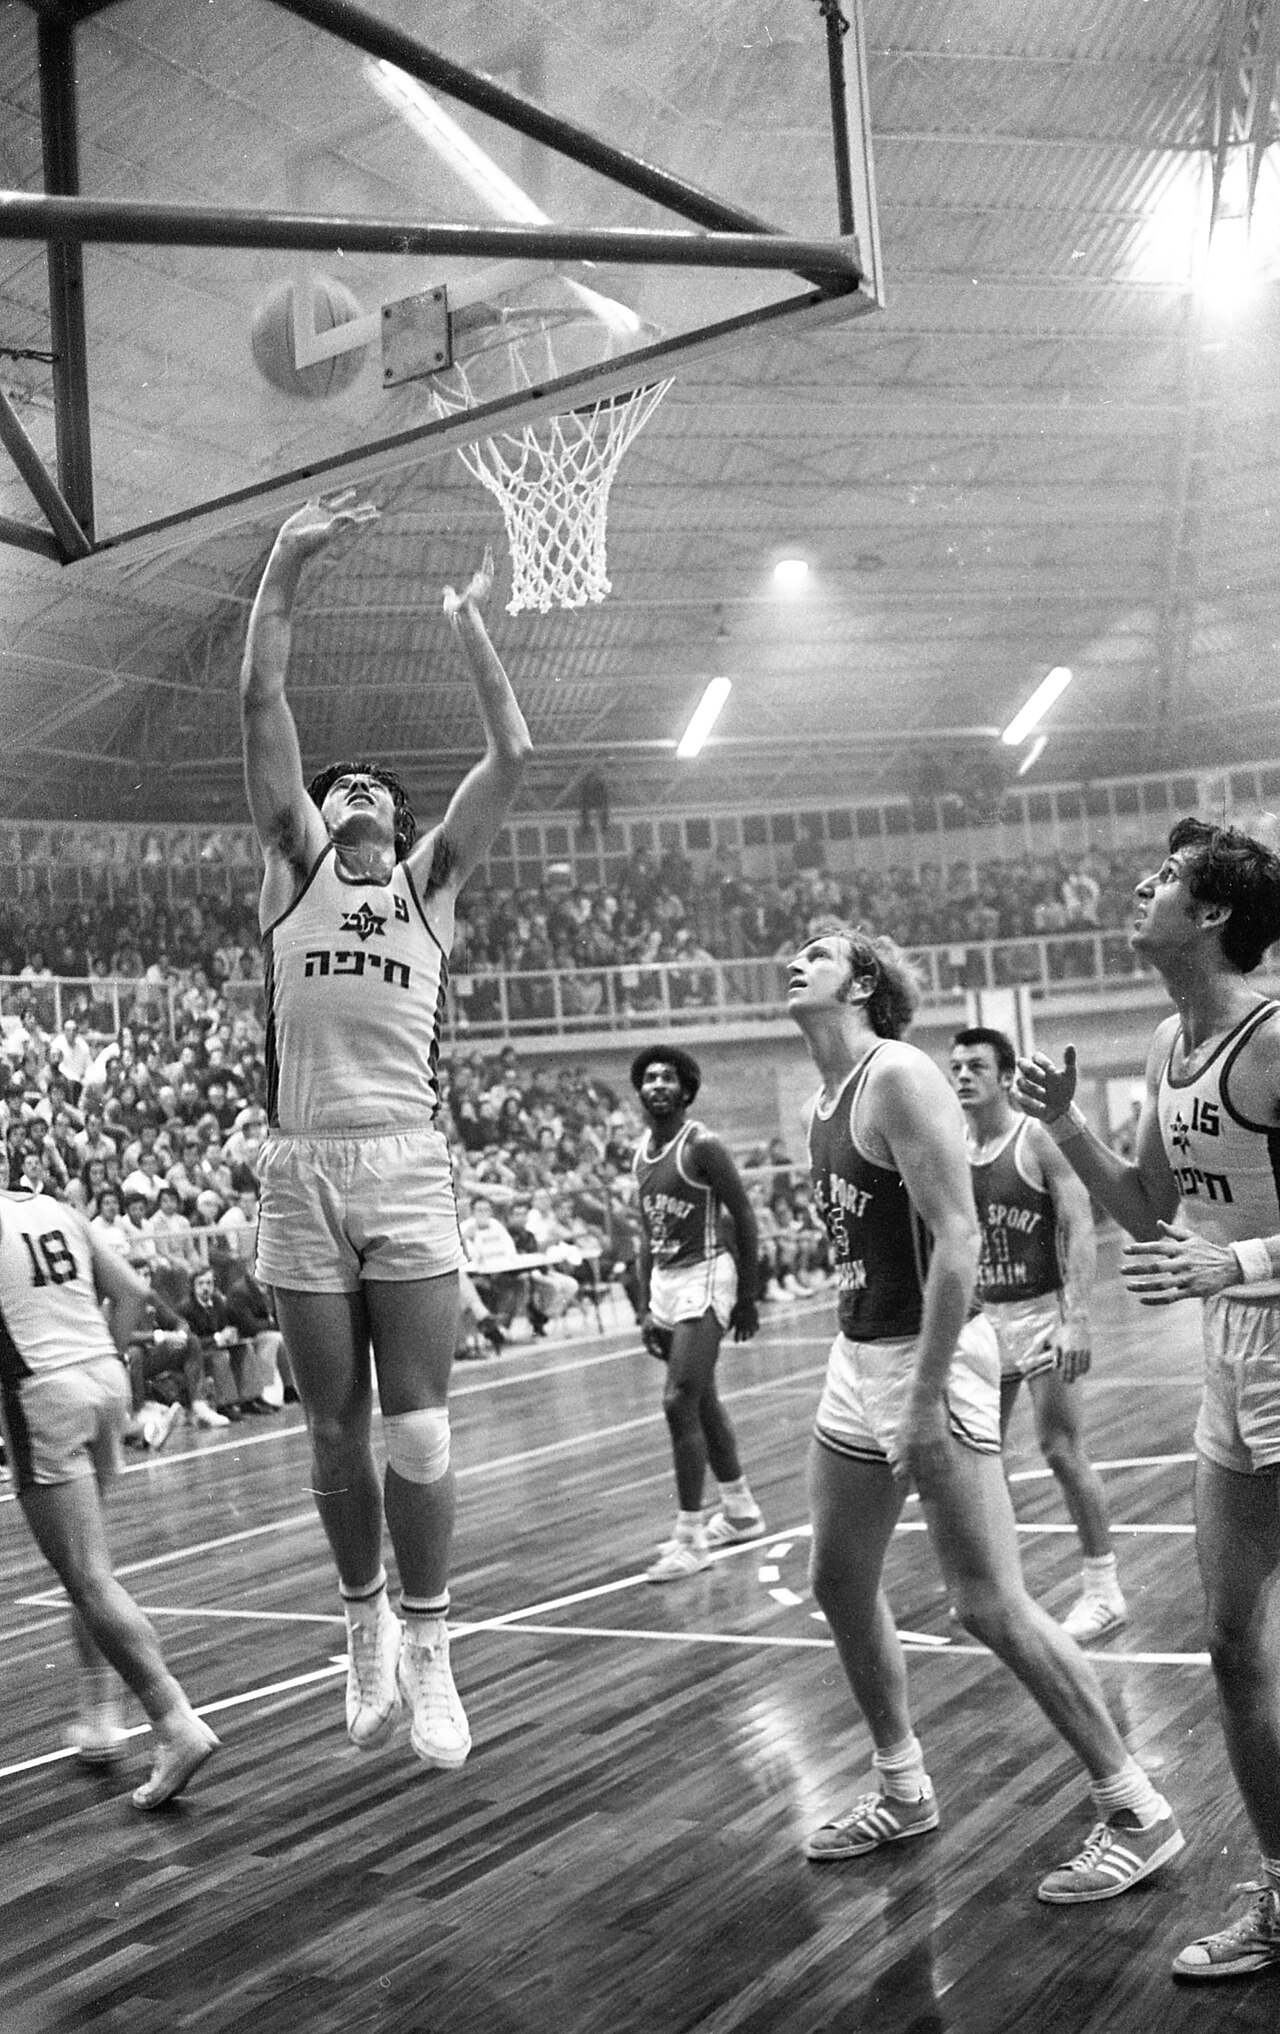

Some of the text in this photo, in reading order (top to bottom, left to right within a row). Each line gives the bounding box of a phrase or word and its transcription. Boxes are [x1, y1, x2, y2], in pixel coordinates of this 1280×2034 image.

[393, 894, 410, 923] 9
[304, 950, 411, 989] חיפה
[1191, 1097, 1219, 1136] 15
[828, 1172, 873, 1218] PORT
[988, 1203, 1042, 1233] SPORT
[21, 1229, 78, 1288] 18
